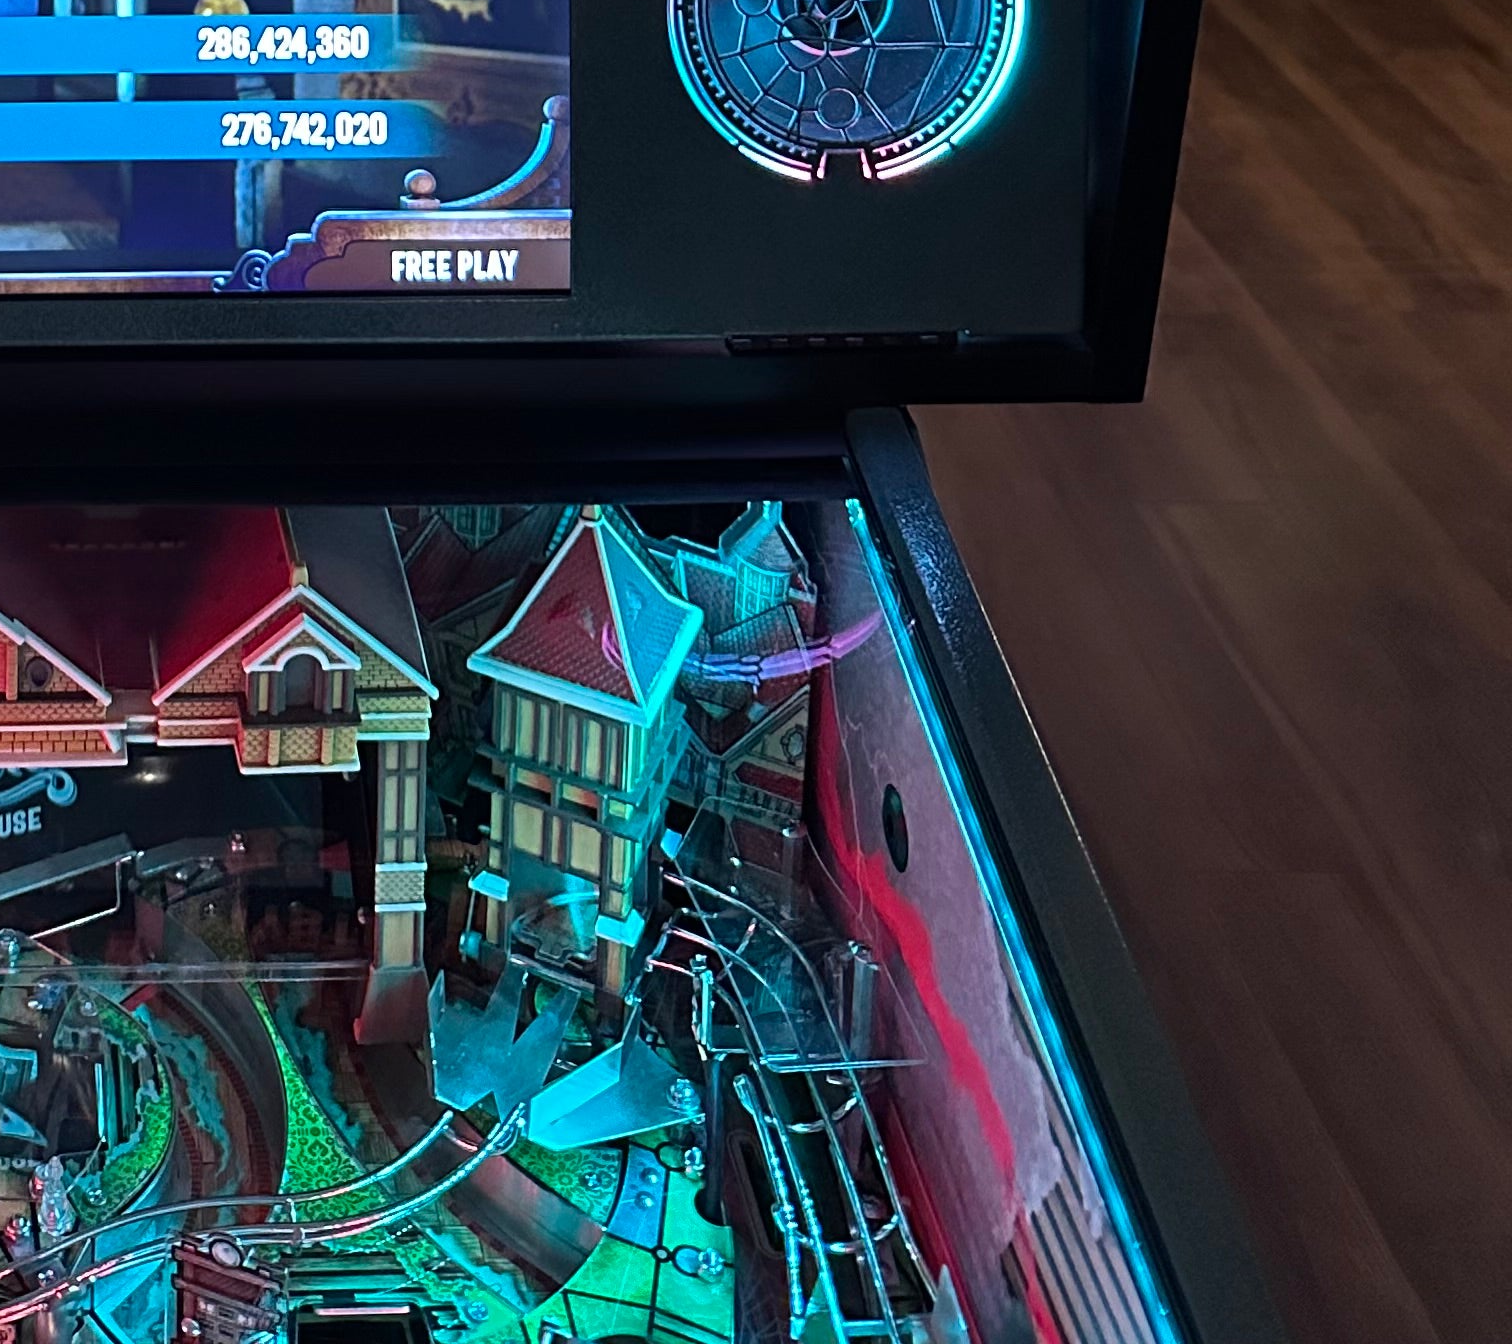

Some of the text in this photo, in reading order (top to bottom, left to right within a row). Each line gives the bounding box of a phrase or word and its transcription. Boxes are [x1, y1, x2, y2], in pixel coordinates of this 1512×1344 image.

[197, 25, 370, 65] 286,424,360
[221, 111, 388, 150] 276,742,020
[391, 250, 519, 281] FREE PLAY
